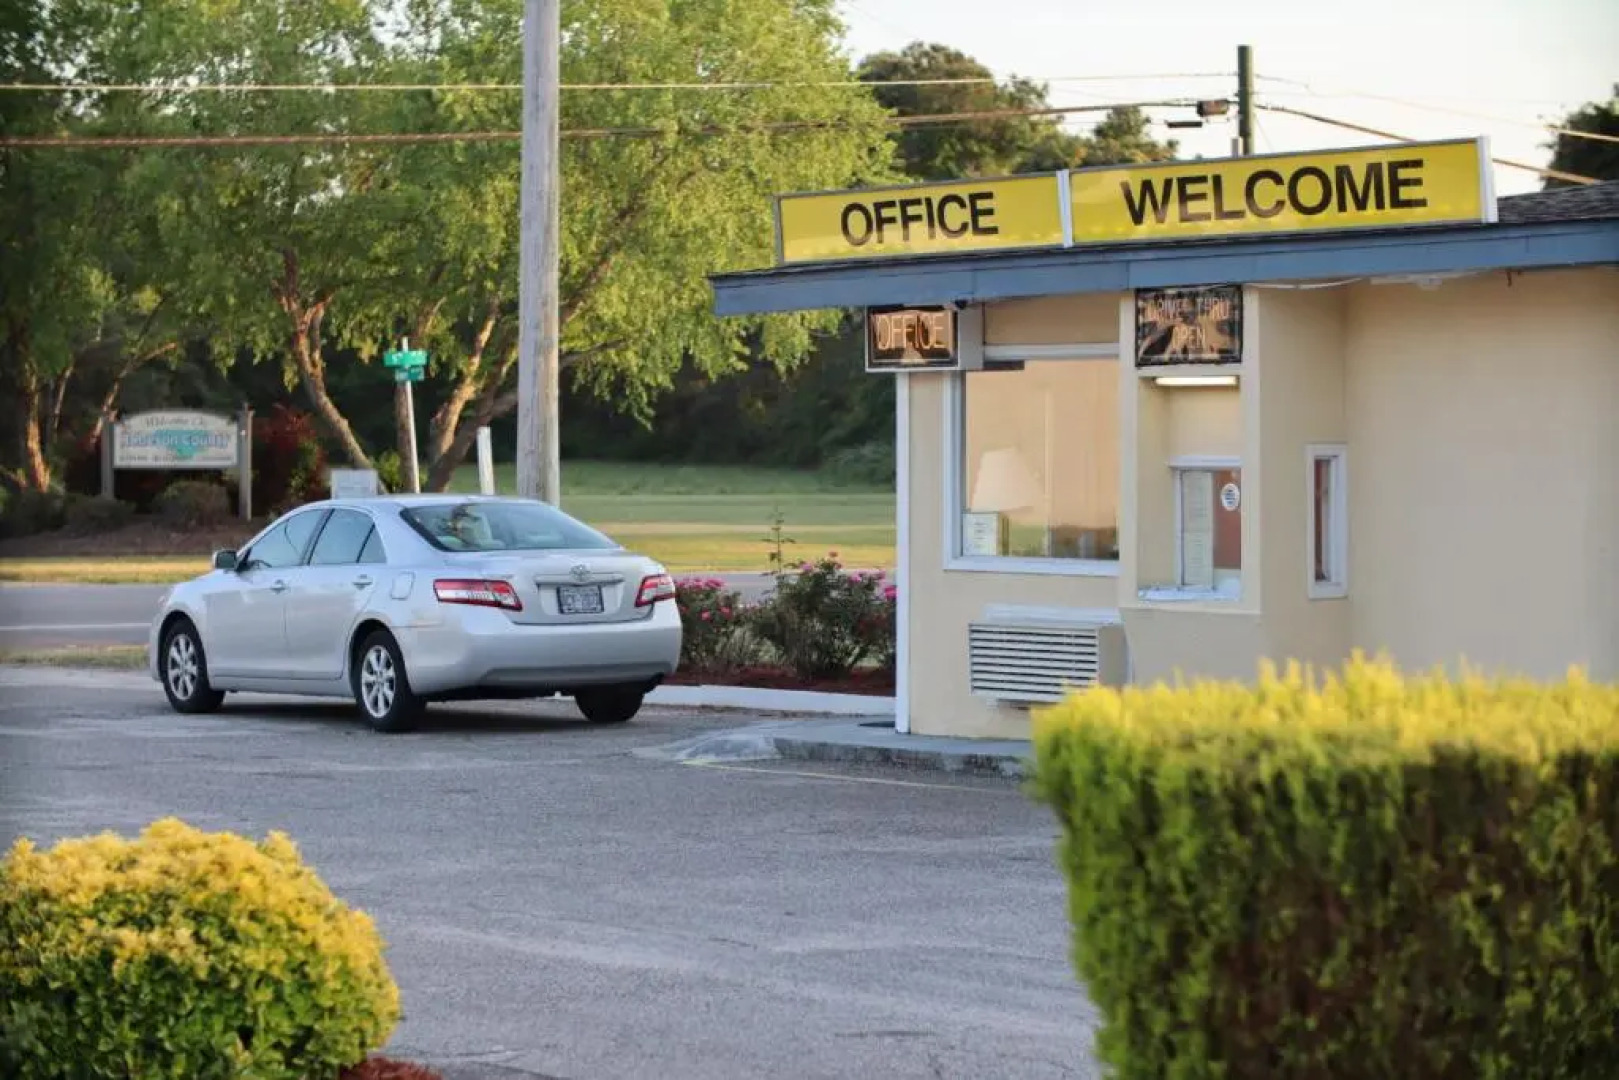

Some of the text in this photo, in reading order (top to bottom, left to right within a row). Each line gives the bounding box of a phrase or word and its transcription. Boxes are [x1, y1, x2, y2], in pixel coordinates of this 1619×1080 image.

[1121, 160, 1427, 226] WELCOME
[840, 191, 999, 247] OFFICE
[877, 313, 945, 350] OFFICE
[1172, 326, 1206, 349] OPEN
